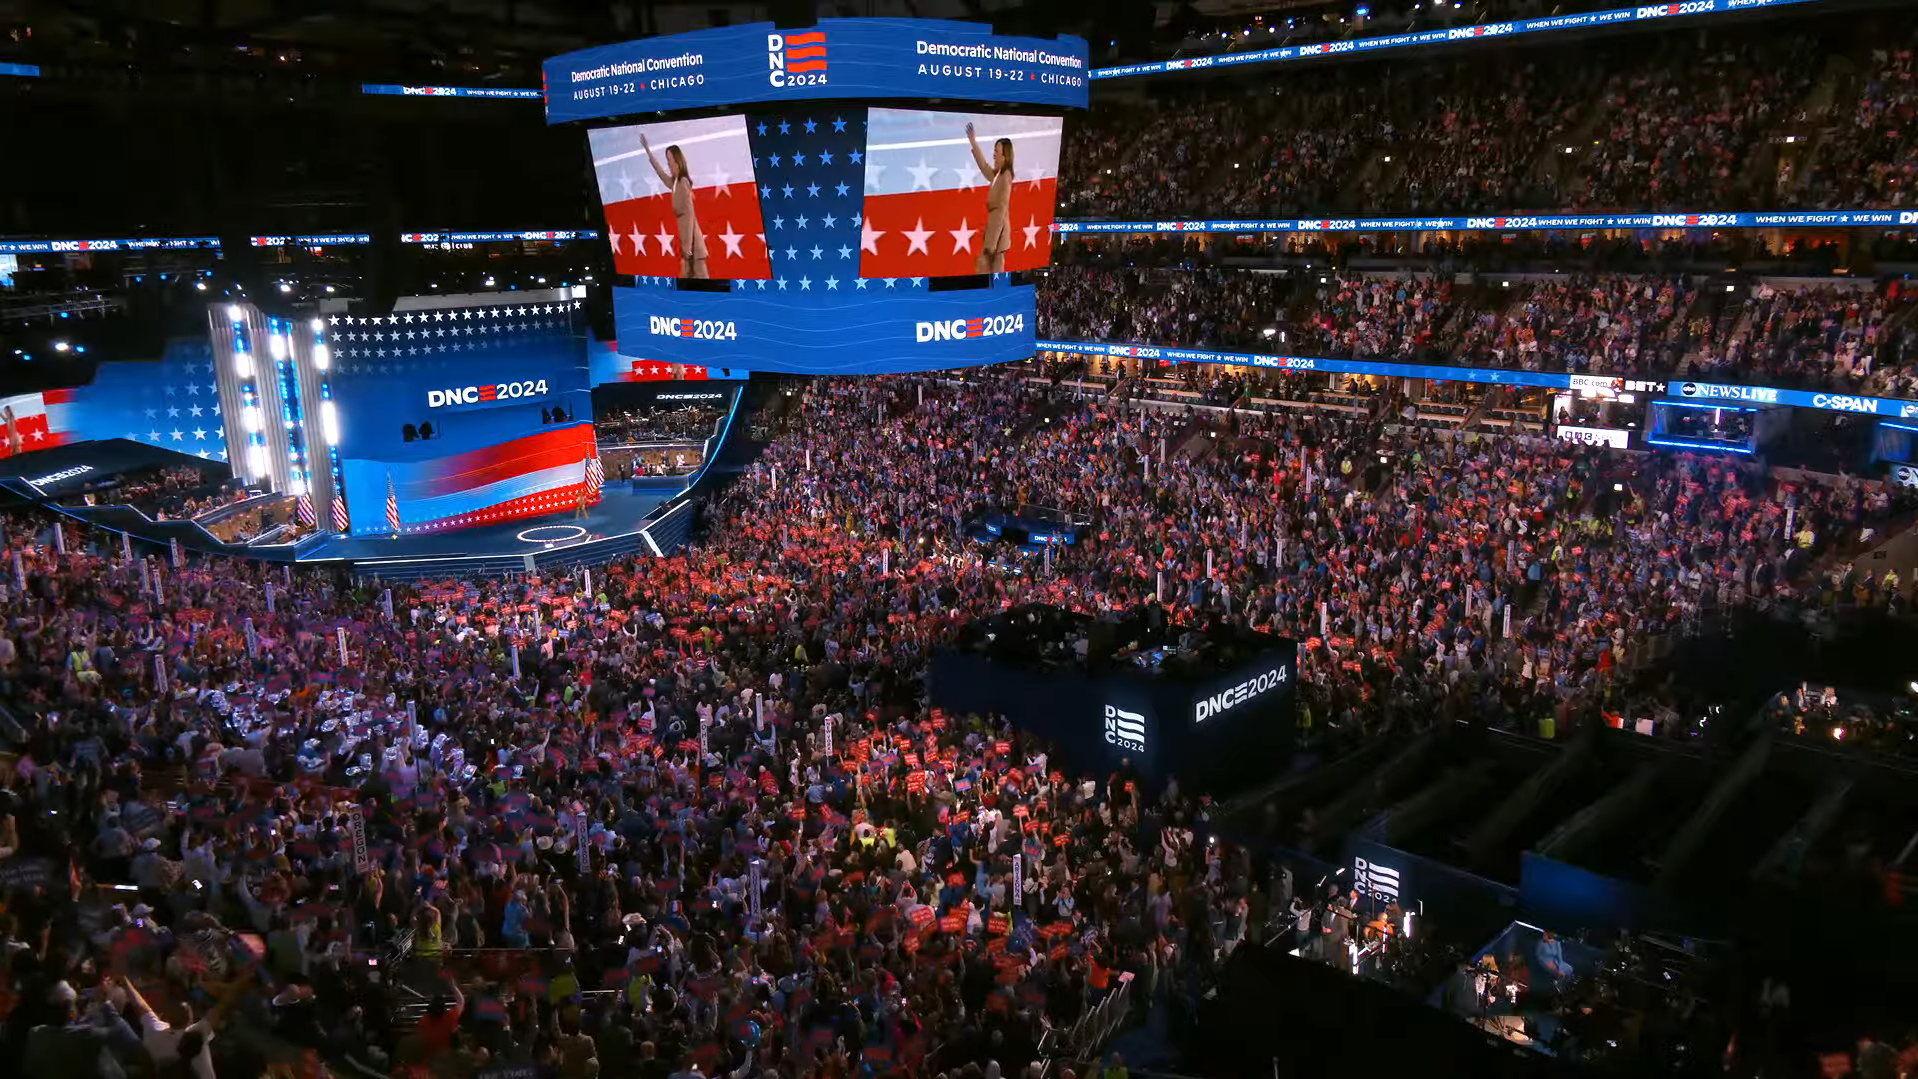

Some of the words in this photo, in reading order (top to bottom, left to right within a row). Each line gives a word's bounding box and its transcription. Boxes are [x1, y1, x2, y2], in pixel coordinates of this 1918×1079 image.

[1637, 6, 1667, 19] DNC
[1679, 0, 1714, 14] 2024
[1564, 17, 1587, 25] FIGHT
[1614, 11, 1630, 20] WIN
[1449, 28, 1474, 40] DNC
[1483, 24, 1513, 35] 2024
[916, 39, 991, 59] Democratic
[993, 45, 1036, 63] National
[1038, 49, 1082, 69] Convention
[1300, 45, 1321, 56] DNC
[1329, 41, 1354, 53] 2024
[768, 34, 784, 88] DNC
[1167, 60, 1185, 70] DNC
[1191, 58, 1213, 68] 2024
[1245, 53, 1261, 61] FIGHT
[571, 64, 609, 83] Democratic
[610, 59, 645, 76] National
[647, 52, 703, 71] Convention
[918, 63, 984, 78] AUGUST
[988, 68, 1024, 82] 19-22
[1040, 72, 1082, 87] CHICAGO
[573, 86, 606, 101] AUGUST
[609, 83, 635, 96] 19-22
[650, 74, 704, 91] CHICAGO
[787, 73, 827, 87] 2024
[1157, 222, 1176, 231] DNC
[1183, 222, 1205, 230] 2024
[1298, 220, 1321, 230] DNC
[1329, 219, 1356, 229] 2024
[1467, 218, 1495, 228] DNC
[1505, 218, 1537, 228] 2024
[1653, 215, 1686, 226] DNC
[1698, 214, 1737, 225] 2024
[51, 242, 79, 250] DNC
[88, 240, 117, 250] 2024
[650, 315, 681, 337] DNC
[693, 320, 737, 340] 2024
[916, 320, 966, 342] DNC
[982, 314, 1024, 336] 2024
[1109, 345, 1130, 356] DNC
[1137, 348, 1160, 357] 2024
[1254, 356, 1278, 367] DNC
[1287, 358, 1314, 369] 2024
[428, 386, 479, 408] DNC
[497, 380, 548, 400] 2024
[1196, 689, 1235, 722] DNC
[1248, 665, 1287, 698] 2024
[1105, 704, 1116, 744] DNC
[1118, 738, 1144, 752] 2024
[353, 812, 366, 863] OREGON
[1354, 856, 1367, 894] DNC
